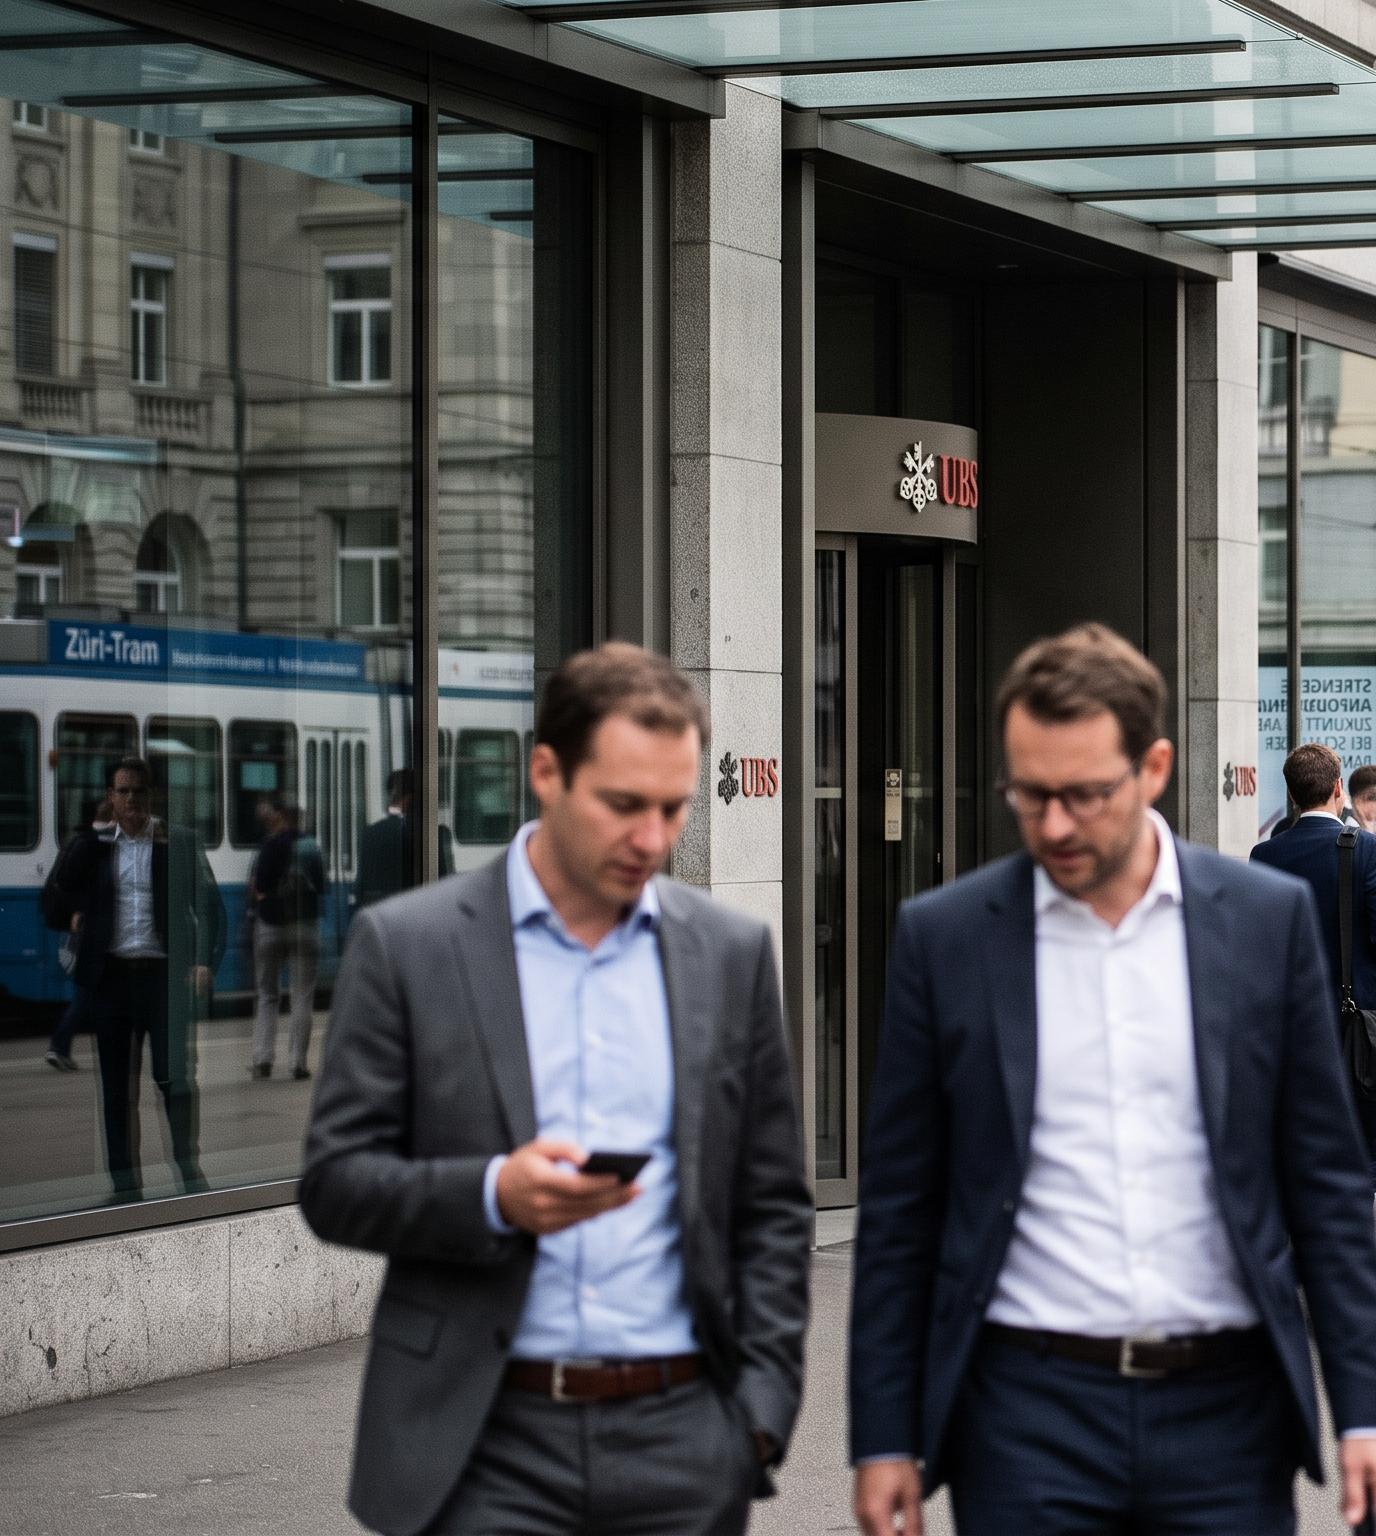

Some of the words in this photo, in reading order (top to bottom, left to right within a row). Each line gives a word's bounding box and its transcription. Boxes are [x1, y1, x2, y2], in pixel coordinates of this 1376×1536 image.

[939, 453, 978, 509] UBS
[64, 627, 160, 666] Züri-Tram
[741, 757, 779, 798] UBS
